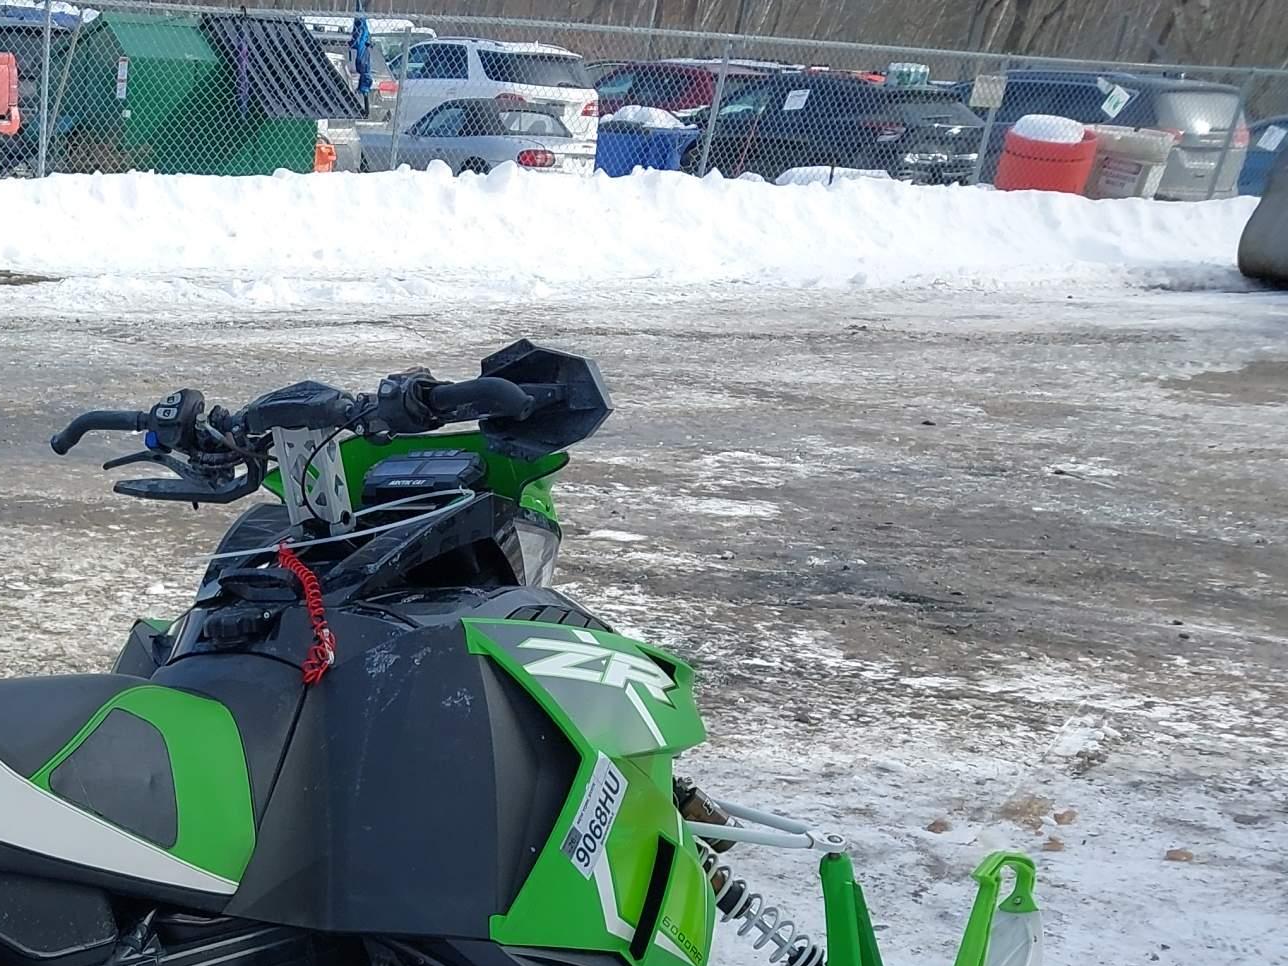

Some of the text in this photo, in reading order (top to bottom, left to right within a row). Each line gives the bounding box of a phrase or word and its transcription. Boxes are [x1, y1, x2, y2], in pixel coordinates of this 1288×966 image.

[516, 636, 678, 710] ZR
[575, 769, 621, 868] 9068HU
[662, 915, 704, 965] 6000RR
